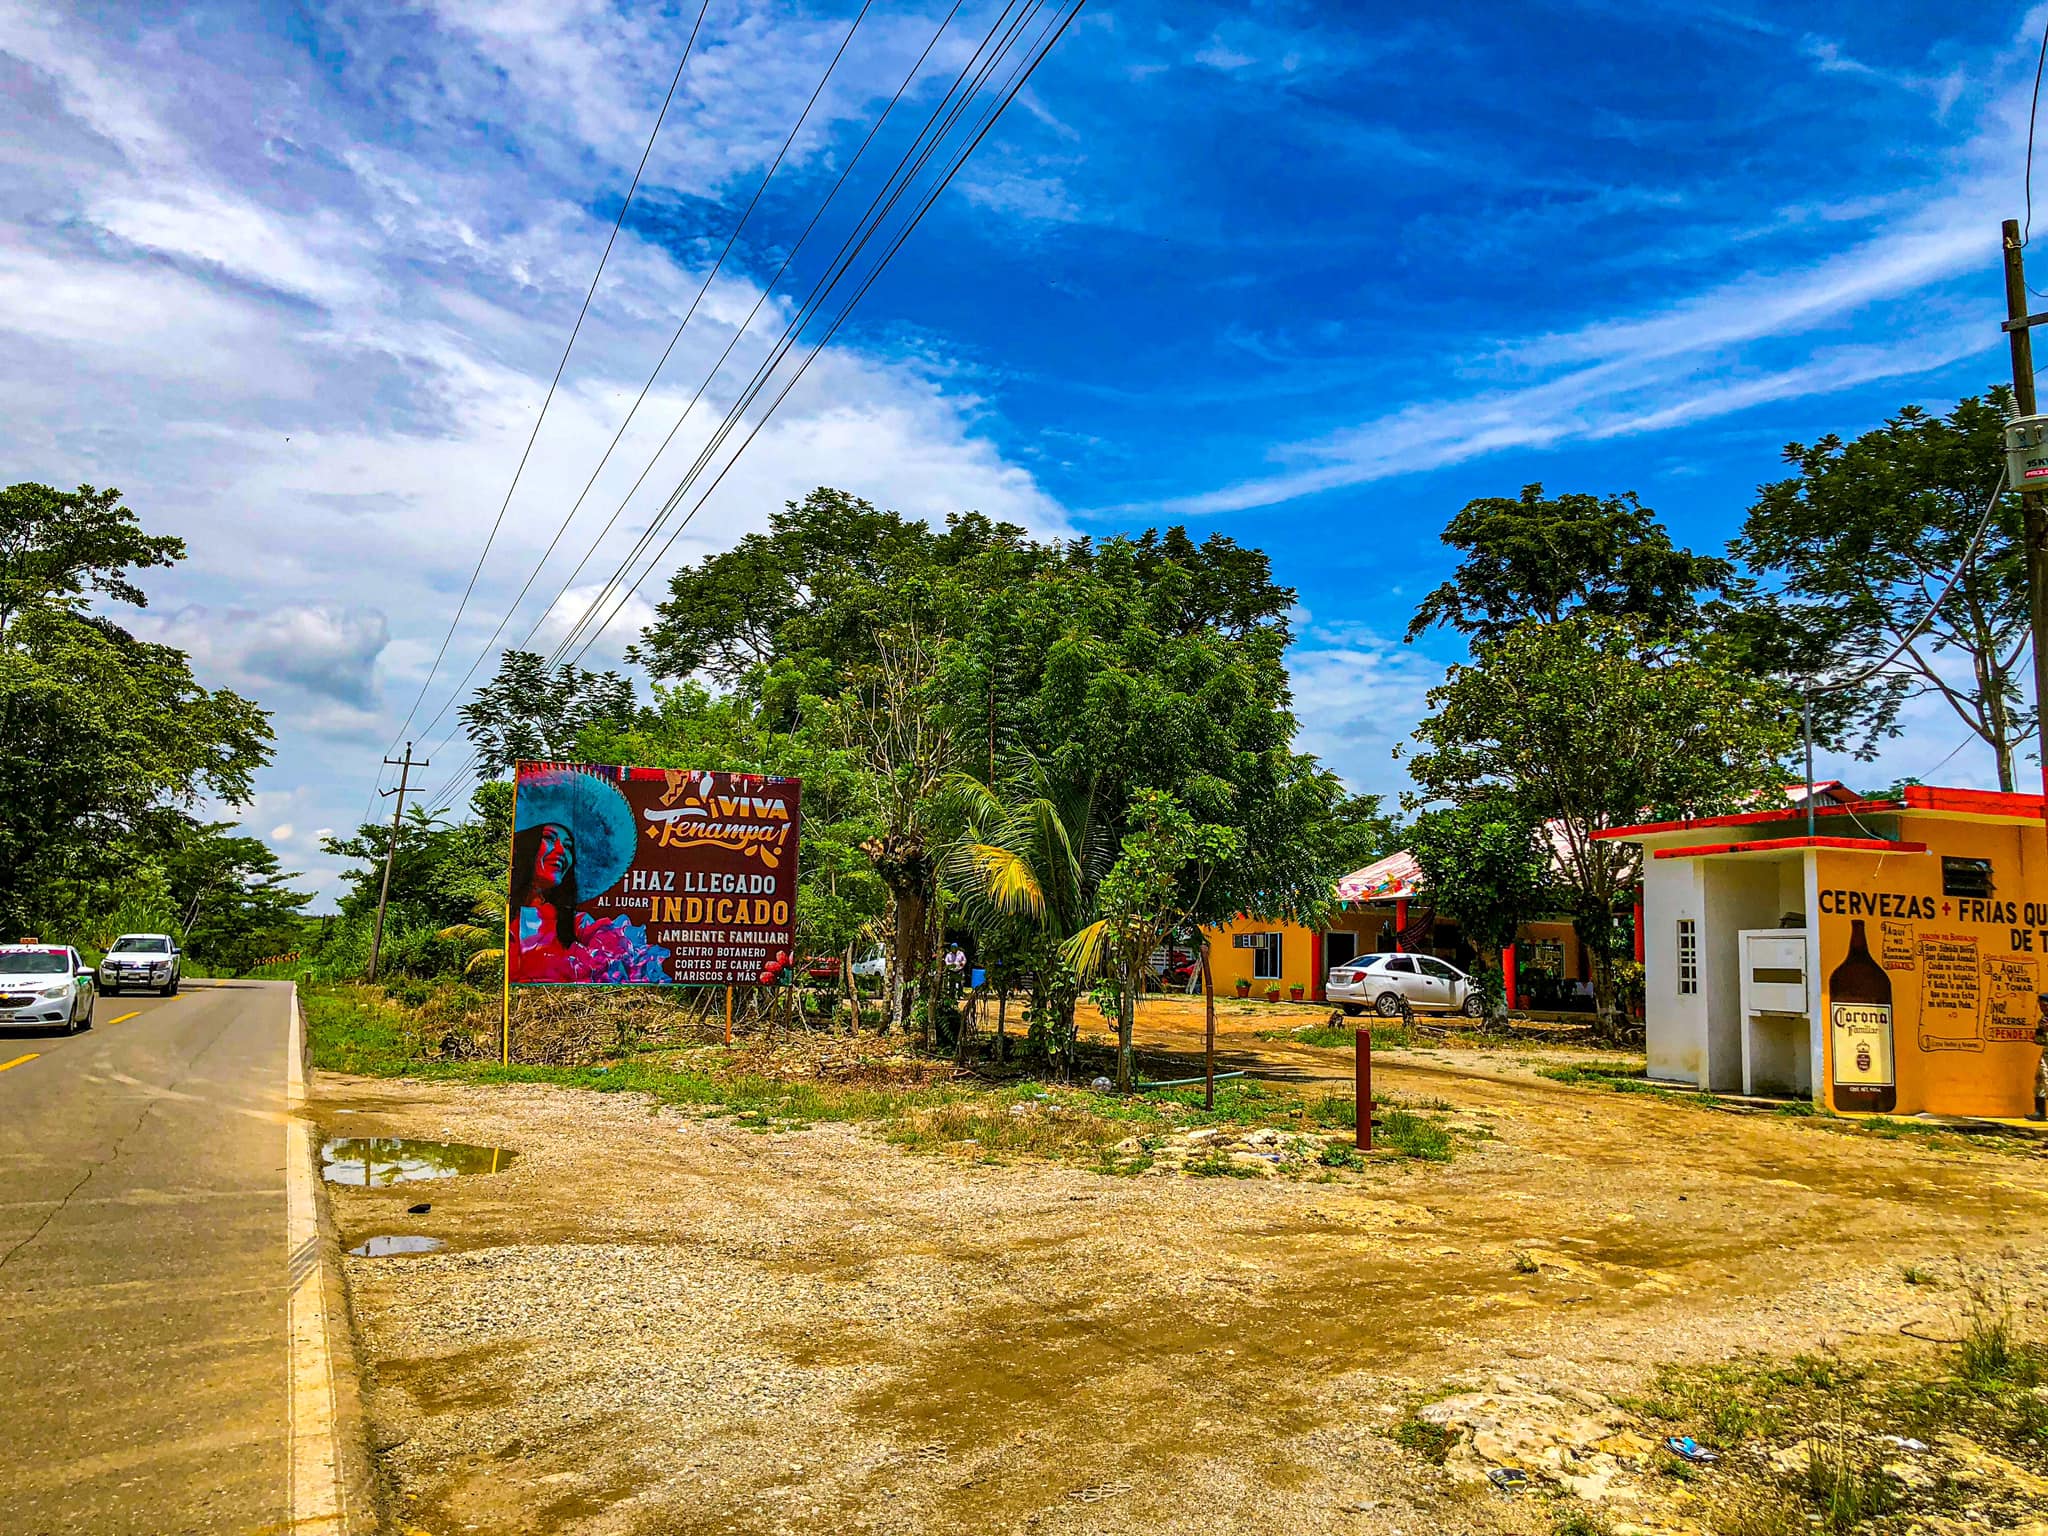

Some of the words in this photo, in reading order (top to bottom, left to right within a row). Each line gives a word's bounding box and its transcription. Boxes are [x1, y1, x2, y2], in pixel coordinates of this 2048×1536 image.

[709, 795, 789, 820] ¡VIVA
[644, 807, 791, 854] Tenampa!
[623, 870, 675, 893] ¡HAZ
[684, 872, 776, 894] LLEGADO
[597, 896, 611, 907] AL
[615, 897, 649, 908] LUGAR
[650, 895, 789, 926] INDICADO
[1819, 889, 1936, 920] CERVEZAS
[1958, 898, 2017, 924] FRIAS
[657, 929, 726, 944] ¡AMBIENTE
[729, 930, 789, 945] FAMILIAR!
[2010, 928, 2033, 952] DE
[675, 946, 714, 957] CENTRO
[717, 947, 766, 958] BOTANERO
[674, 971, 723, 981] MARISCOS
[726, 972, 733, 981] &
[736, 969, 757, 982] MÁS
[675, 959, 711, 969] CORTES
[715, 960, 727, 969] DE
[730, 960, 762, 970] CARNE
[1834, 1007, 1888, 1028] Corona
